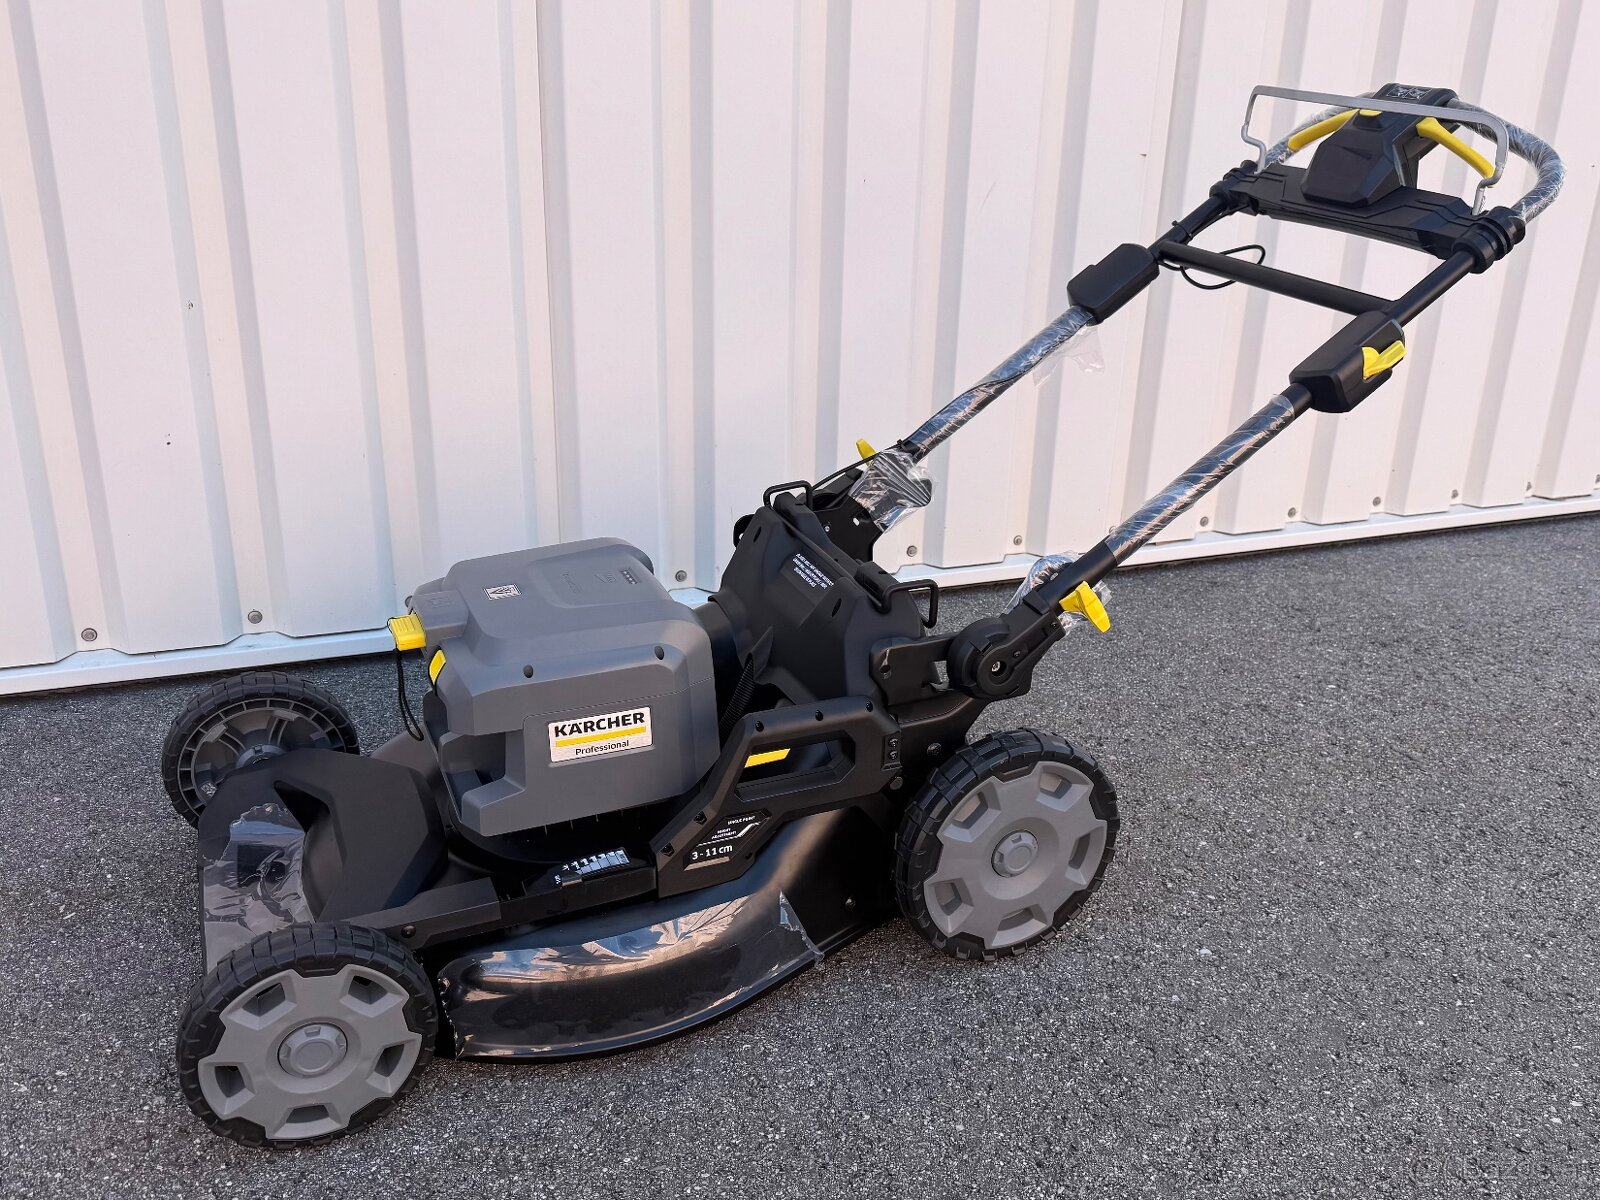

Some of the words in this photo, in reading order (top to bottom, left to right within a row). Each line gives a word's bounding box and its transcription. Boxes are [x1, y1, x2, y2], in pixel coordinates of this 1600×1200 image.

[554, 712, 645, 737] KÄRCHER
[575, 740, 630, 755] Professional
[691, 851, 699, 860] 3
[705, 847, 718, 857] 11
[718, 844, 733, 854] cm
